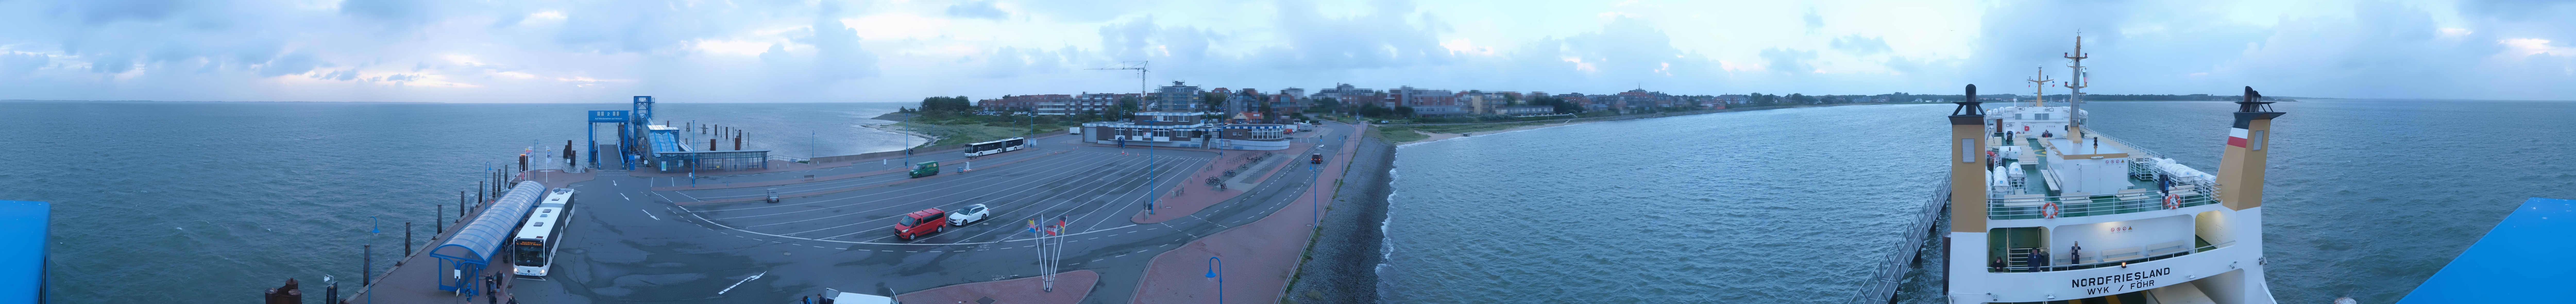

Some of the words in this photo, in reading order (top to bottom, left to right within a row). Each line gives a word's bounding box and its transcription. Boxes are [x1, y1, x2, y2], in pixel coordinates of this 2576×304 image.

[2072, 267, 2170, 288] NORDFRIESLAND
[2087, 286, 2109, 295] WYK
[2131, 280, 2154, 290] FÖHR
